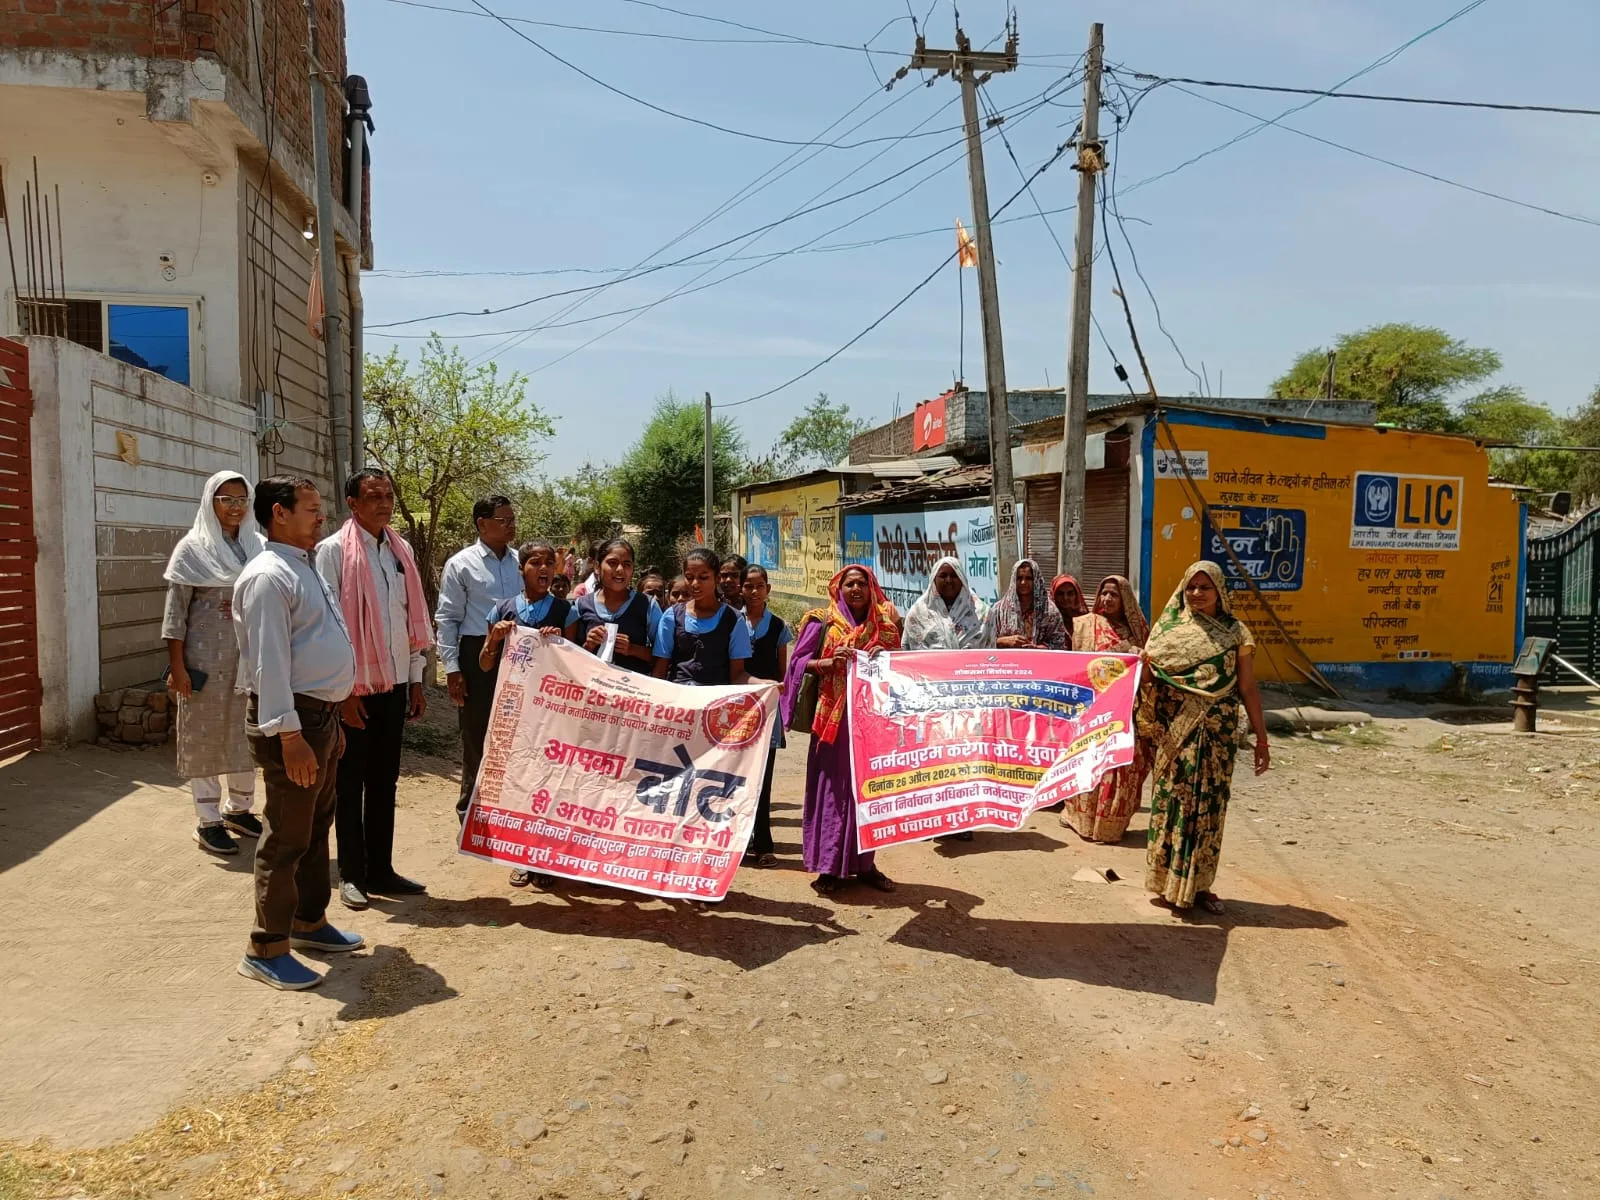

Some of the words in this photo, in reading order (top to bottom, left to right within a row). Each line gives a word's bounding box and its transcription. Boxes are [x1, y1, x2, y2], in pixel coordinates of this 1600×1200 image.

[1213, 468, 1237, 485] अपने
[1238, 467, 1264, 485] जीवन
[1266, 471, 1276, 486] के
[1247, 491, 1256, 502] के
[1260, 493, 1280, 504] साथ
[1403, 483, 1453, 526] LIC
[1386, 529, 1408, 540] जीवन
[1413, 529, 1432, 540] बीमा
[968, 550, 988, 577] सोना
[1357, 568, 1372, 582] हर
[1374, 568, 1391, 579] पल
[1394, 565, 1422, 580] आपके
[1425, 569, 1446, 580] साथ
[1383, 597, 1400, 610] मनी
[1362, 612, 1408, 629] परिपक्वता
[1373, 635, 1391, 649] पूरा
[539, 674, 586, 702] दिनांक
[587, 688, 607, 708] 26
[610, 693, 651, 717] अप्रैल
[654, 704, 698, 726] 2024
[991, 680, 1010, 691] वोट
[1013, 680, 1041, 691] करके
[1044, 684, 1069, 697] आना
[1071, 686, 1080, 699] है
[532, 695, 545, 707] को
[545, 701, 567, 715] अपने
[568, 706, 607, 723] मताधिकार
[608, 713, 619, 726] का
[620, 715, 648, 731] उपयोग
[648, 723, 675, 737] अवश्य
[1032, 696, 1073, 715] बनाना
[543, 739, 627, 780] आपका
[870, 743, 943, 771] नर्मदापुरम
[947, 740, 990, 758] करेगा
[992, 740, 1024, 761] वोट,
[1028, 745, 1057, 766] युवा
[634, 743, 747, 823] वोट
[868, 778, 895, 794] दिनांक
[896, 778, 907, 789] 26
[908, 772, 931, 785] अप्रैल
[933, 768, 956, 781] 2024
[973, 763, 996, 776] अपने
[531, 788, 551, 816] ही
[556, 801, 618, 832] आपकी
[624, 815, 676, 840] ताकत
[868, 801, 894, 817] जिला
[895, 793, 933, 811] निर्वाचन
[935, 784, 980, 803] अधिकारी
[488, 808, 525, 831] निर्वाचन
[524, 819, 572, 841] अधिकारी
[572, 831, 627, 854] नर्मदापुरम
[628, 843, 649, 859] द्वारा
[651, 845, 691, 865] जनहित
[691, 850, 704, 865] में
[704, 851, 732, 869] जारी
[872, 824, 896, 842] ग्राम
[900, 816, 943, 834] पंचायत
[975, 808, 1019, 824] जनपद
[487, 834, 527, 857] पंचायत
[555, 851, 599, 873] जनपद
[602, 860, 649, 882] पंचायत
